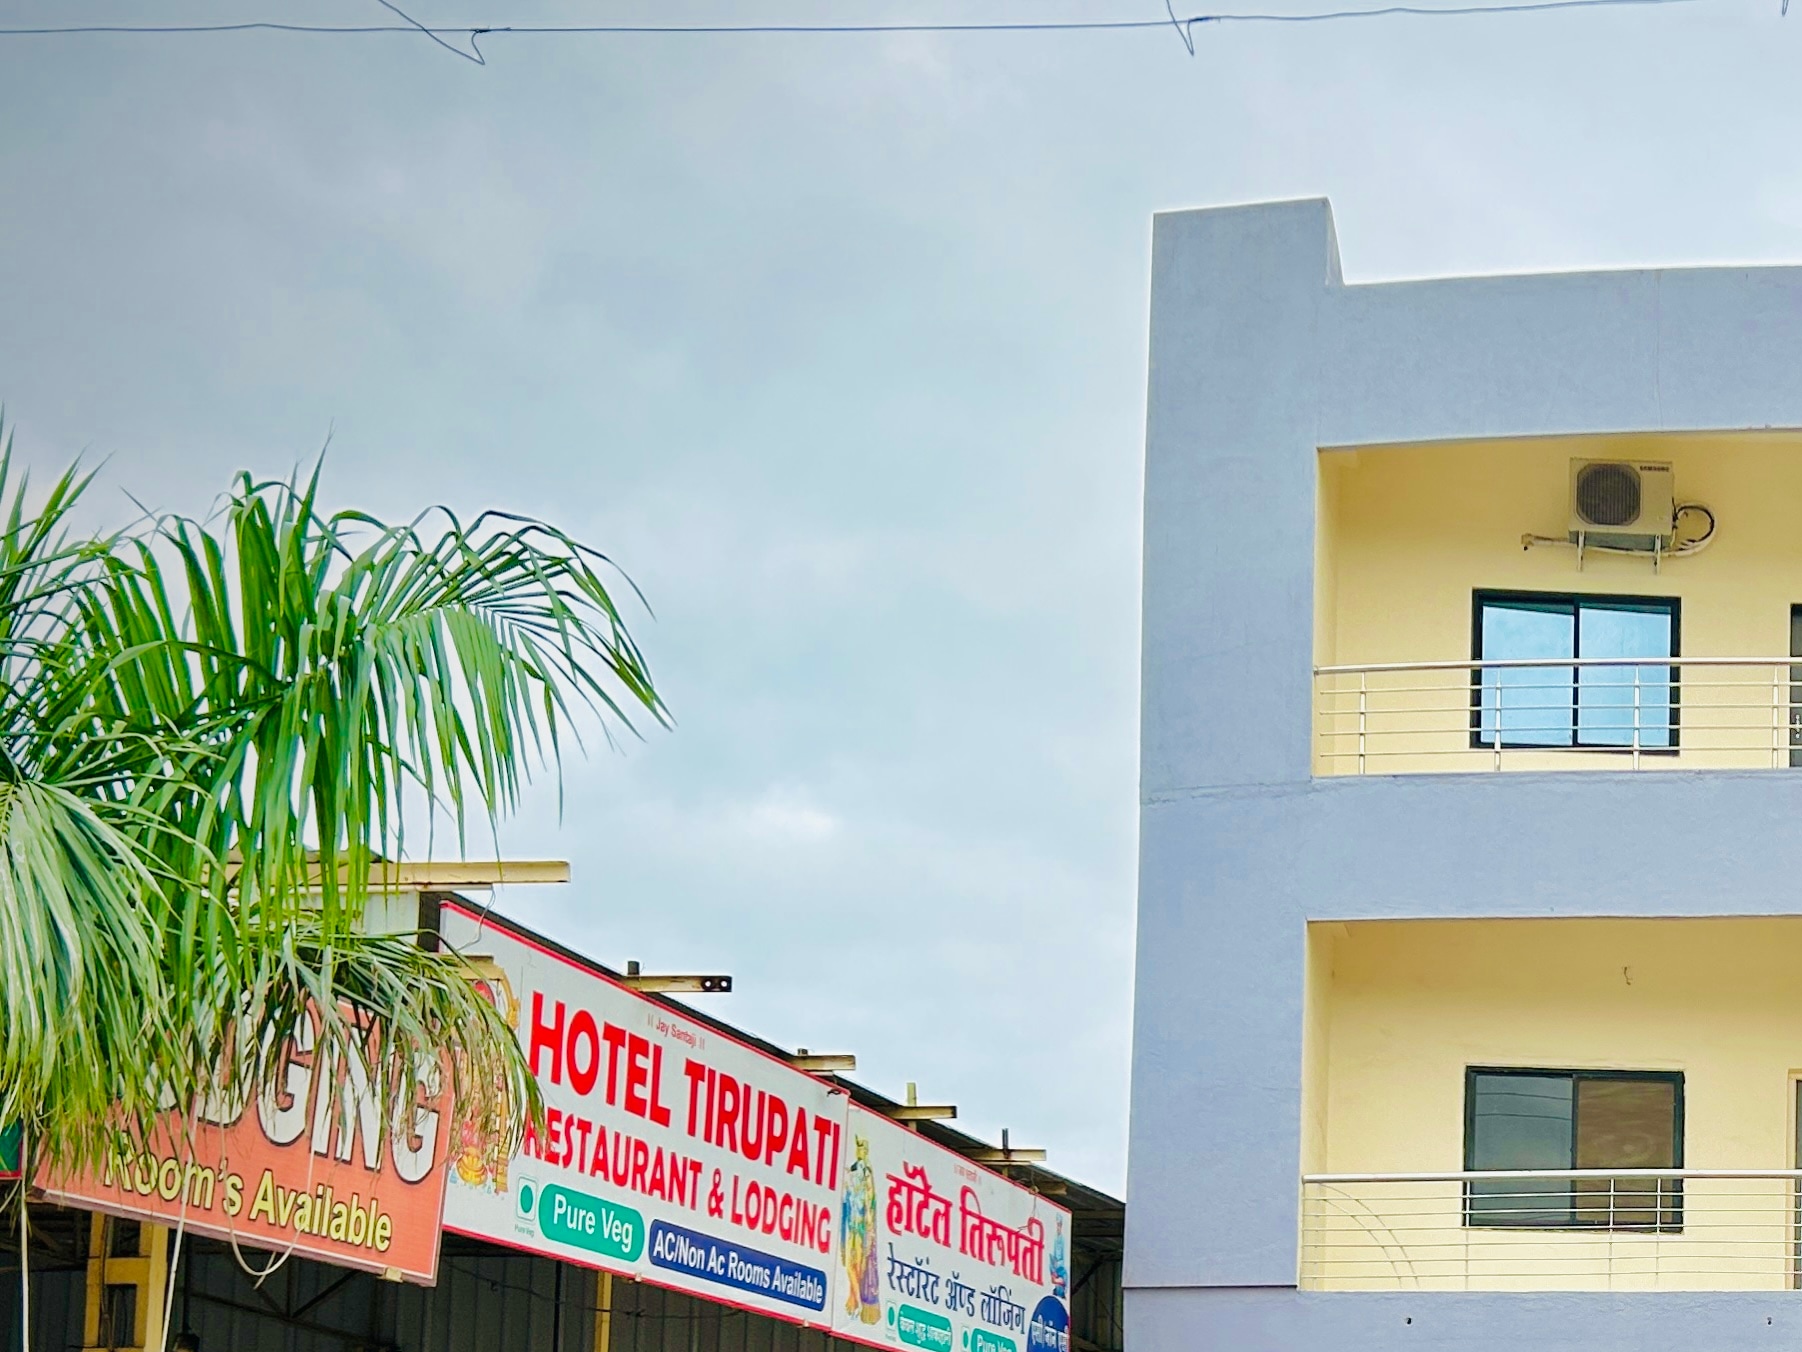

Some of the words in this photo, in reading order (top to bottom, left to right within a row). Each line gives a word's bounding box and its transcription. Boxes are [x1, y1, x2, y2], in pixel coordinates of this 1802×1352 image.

[529, 990, 673, 1128] HOTEL
[684, 1057, 841, 1191] TIRUPATI
[248, 1168, 393, 1253] Available
[523, 1104, 703, 1212] RESTAURANT
[708, 1167, 725, 1219] &
[730, 1175, 832, 1254] LODGING
[885, 1160, 953, 1249] हॉटेल
[553, 1193, 598, 1236] Pure
[602, 1206, 635, 1253] Veg
[653, 1229, 705, 1270] AC/Non
[706, 1246, 726, 1277] Ac
[727, 1251, 771, 1289] Rooms
[771, 1265, 823, 1305] Available
